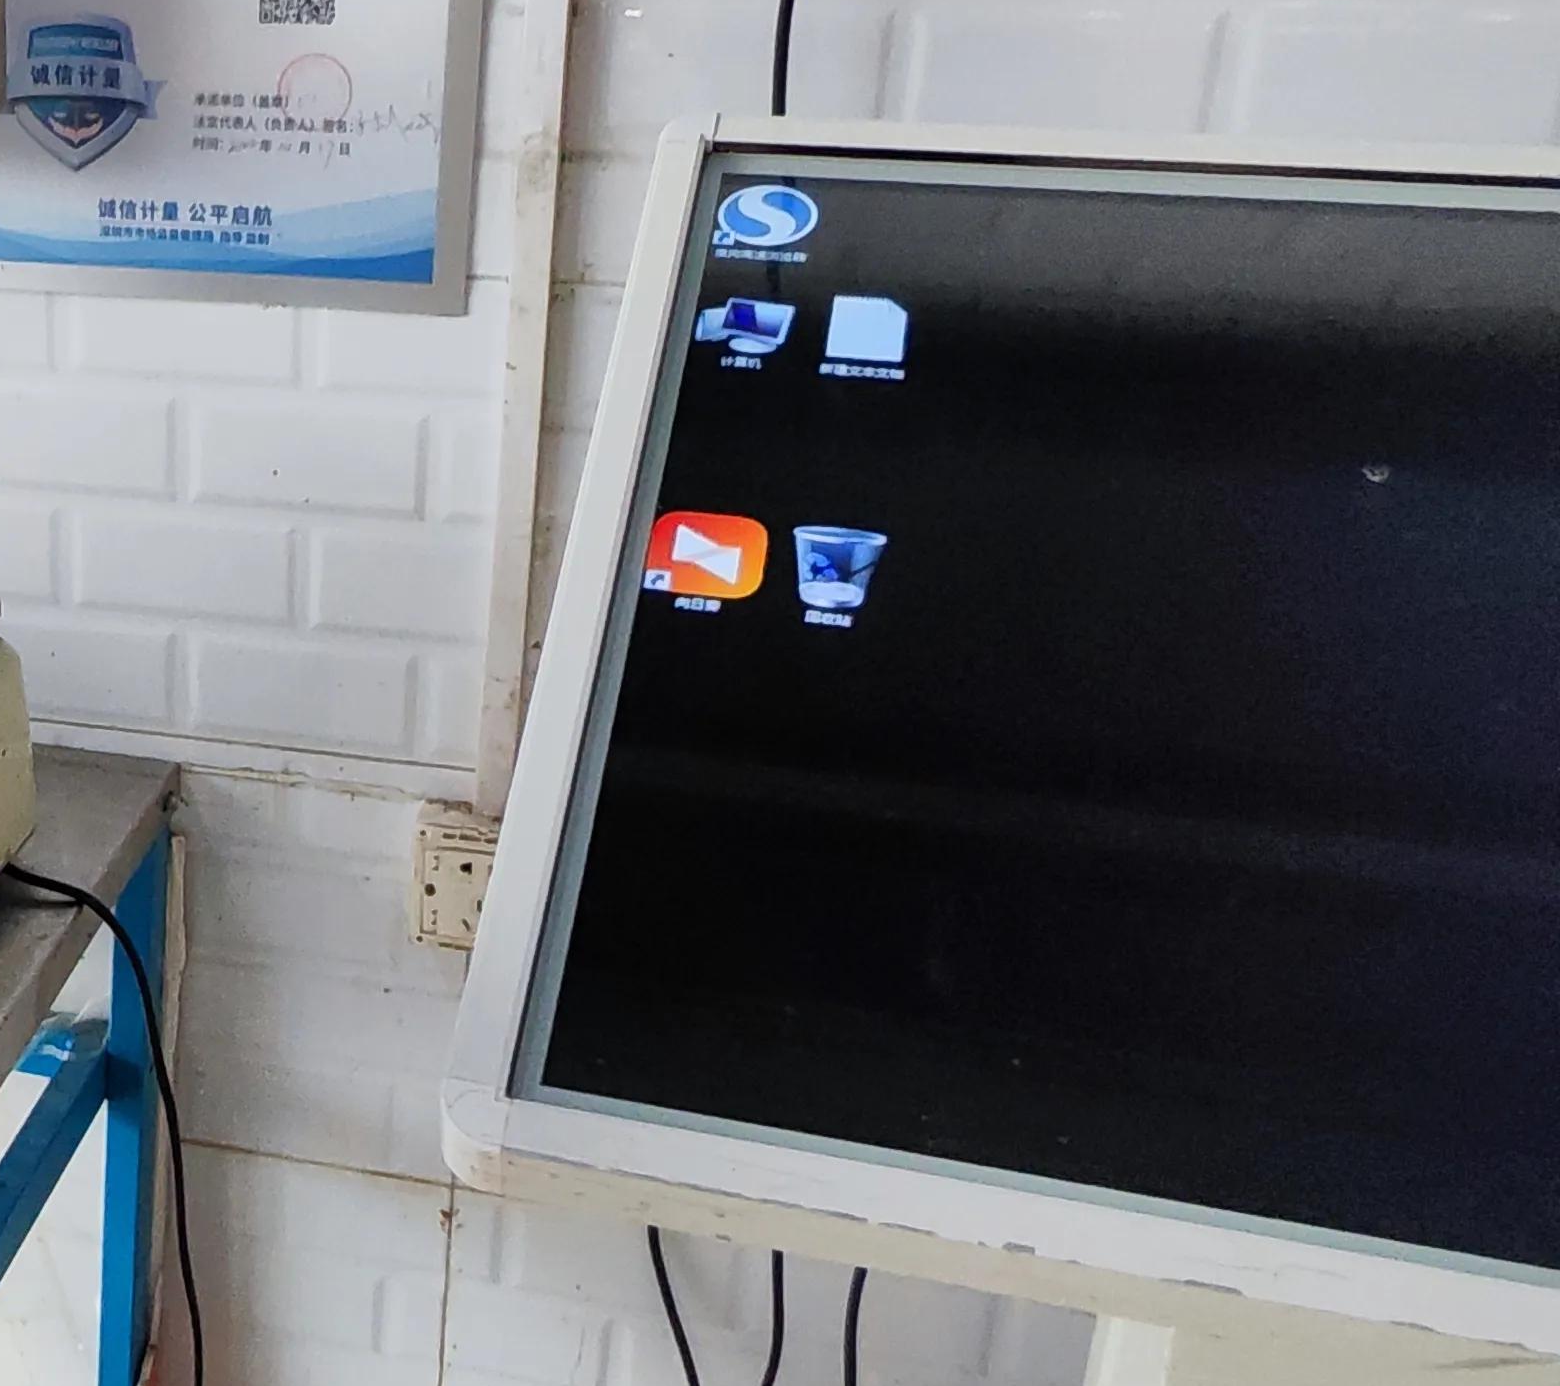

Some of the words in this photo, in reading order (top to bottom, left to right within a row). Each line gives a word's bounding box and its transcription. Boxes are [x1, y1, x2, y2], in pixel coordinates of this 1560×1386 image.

[31, 64, 122, 89] 诚信计量
[97, 197, 180, 222] 诚信计量
[189, 202, 273, 227] 公平启航
